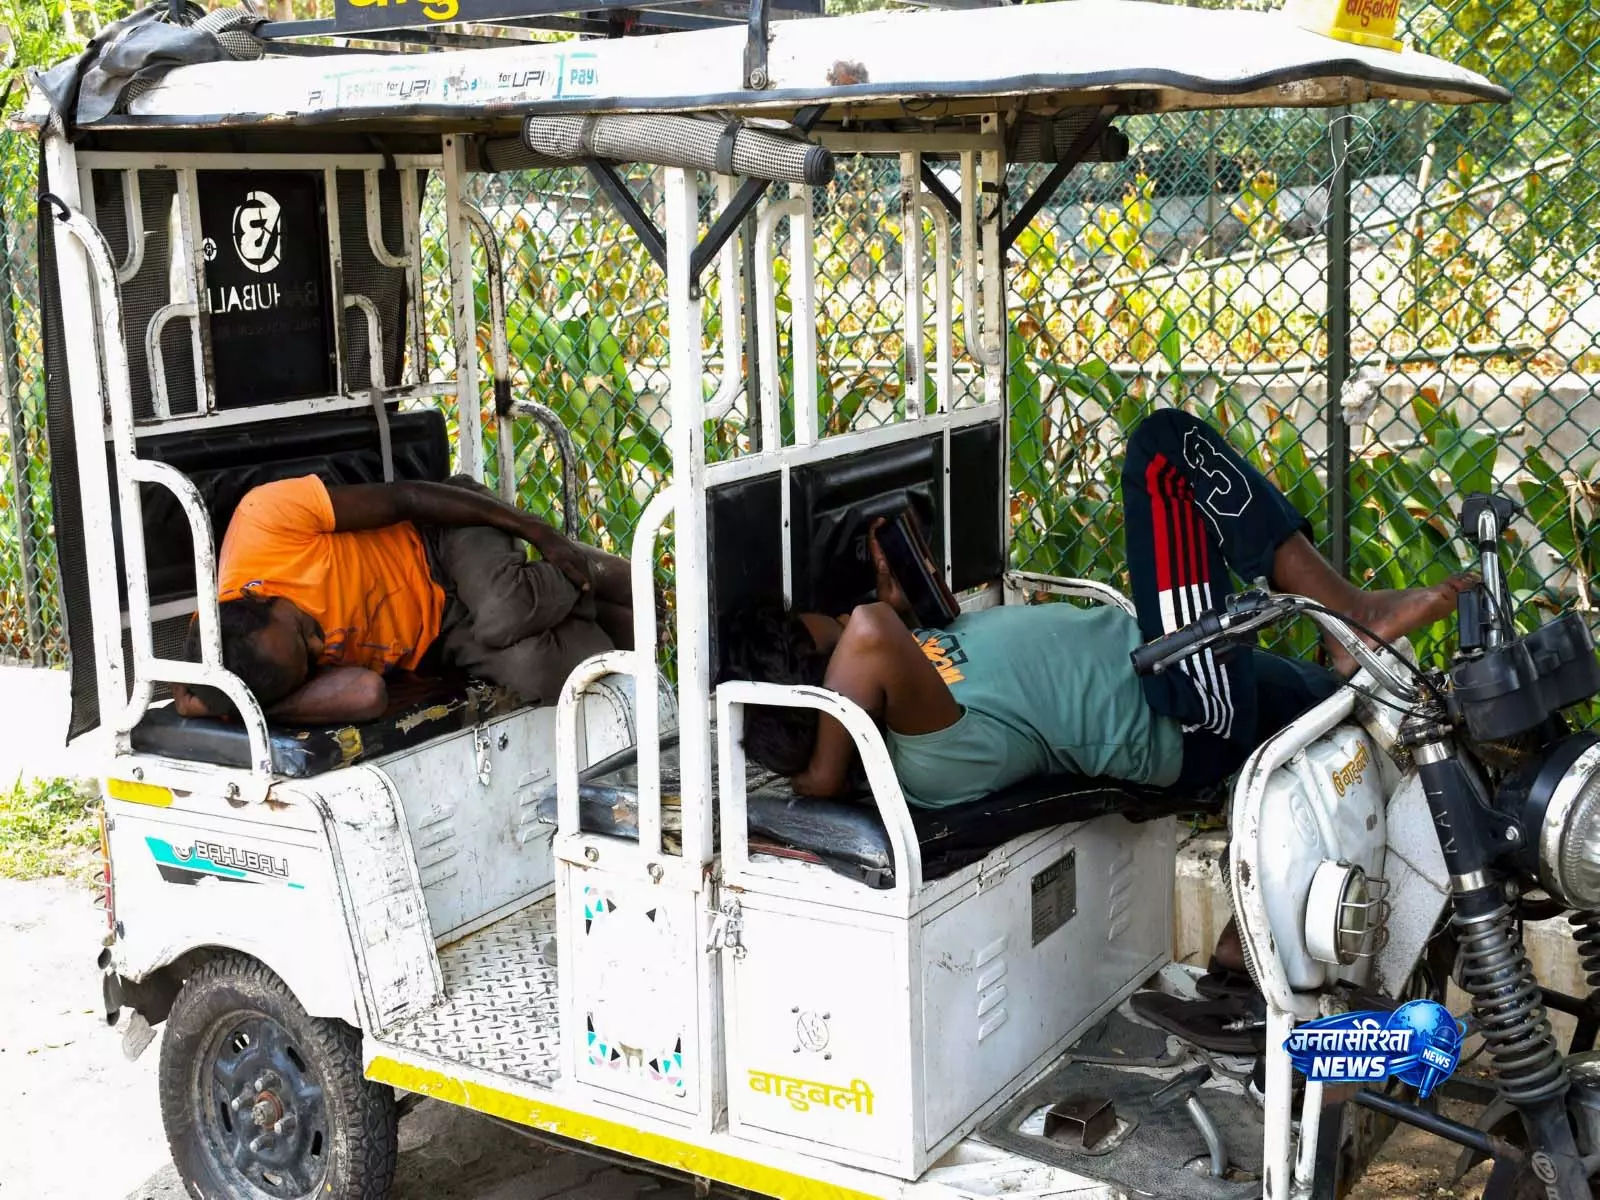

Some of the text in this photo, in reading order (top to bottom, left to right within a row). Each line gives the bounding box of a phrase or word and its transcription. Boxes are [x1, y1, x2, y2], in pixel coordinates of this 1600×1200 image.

[400, 79, 430, 97] UPI
[512, 70, 545, 87] UPI
[194, 840, 289, 878] BAHUBALI
[747, 1069, 874, 1115] बाहुबली
